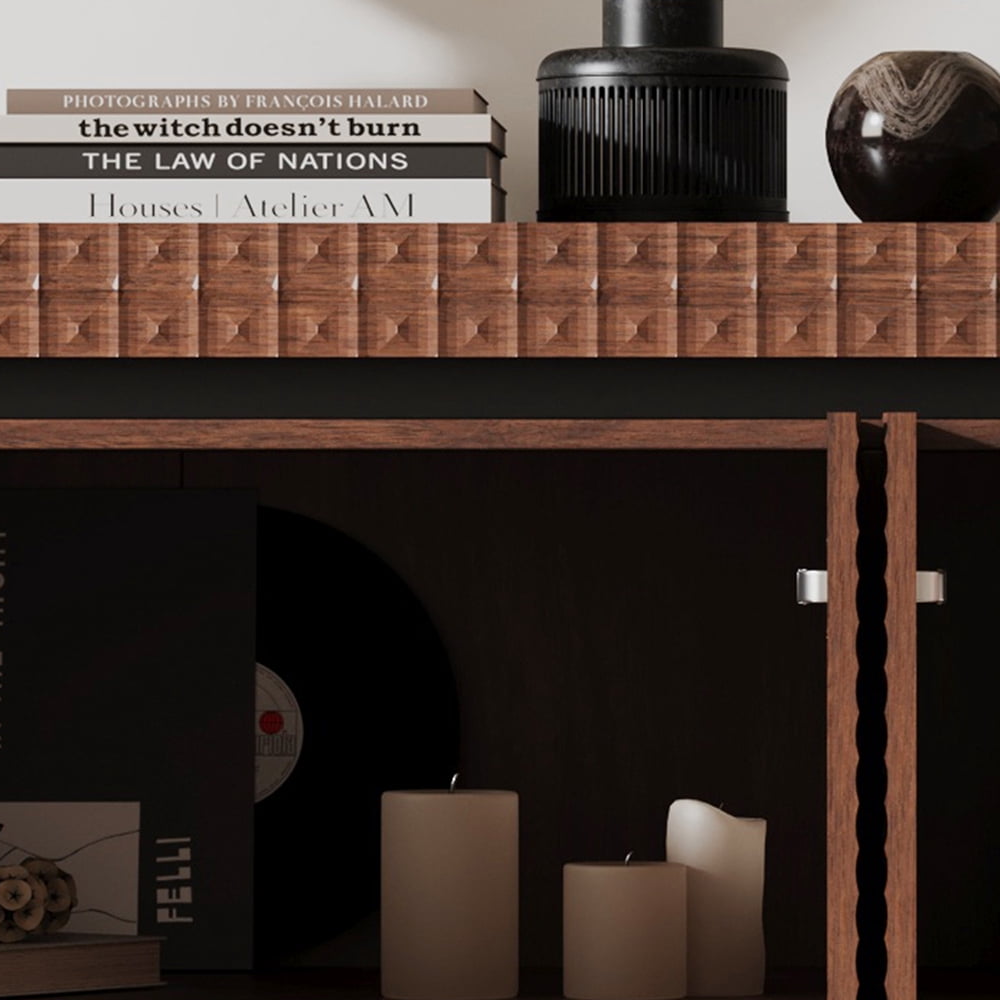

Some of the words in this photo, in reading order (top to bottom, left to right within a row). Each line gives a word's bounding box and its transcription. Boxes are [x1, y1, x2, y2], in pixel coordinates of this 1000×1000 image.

[64, 95, 210, 107] PHOTOGRAPHS
[219, 95, 236, 107] BY
[246, 94, 343, 112] FRANÇOIS
[349, 95, 427, 107] HALARD
[79, 118, 128, 137] the
[134, 118, 220, 137] witch
[226, 118, 340, 136] doesn't
[347, 118, 420, 136] burn
[82, 153, 141, 169] THE
[156, 153, 215, 169] LAW
[228, 153, 265, 170] OF
[279, 153, 408, 170] NATIONS
[91, 193, 202, 217] Houses
[233, 193, 344, 218] Atelier
[350, 193, 415, 218] AM
[156, 837, 193, 922] FELLI
